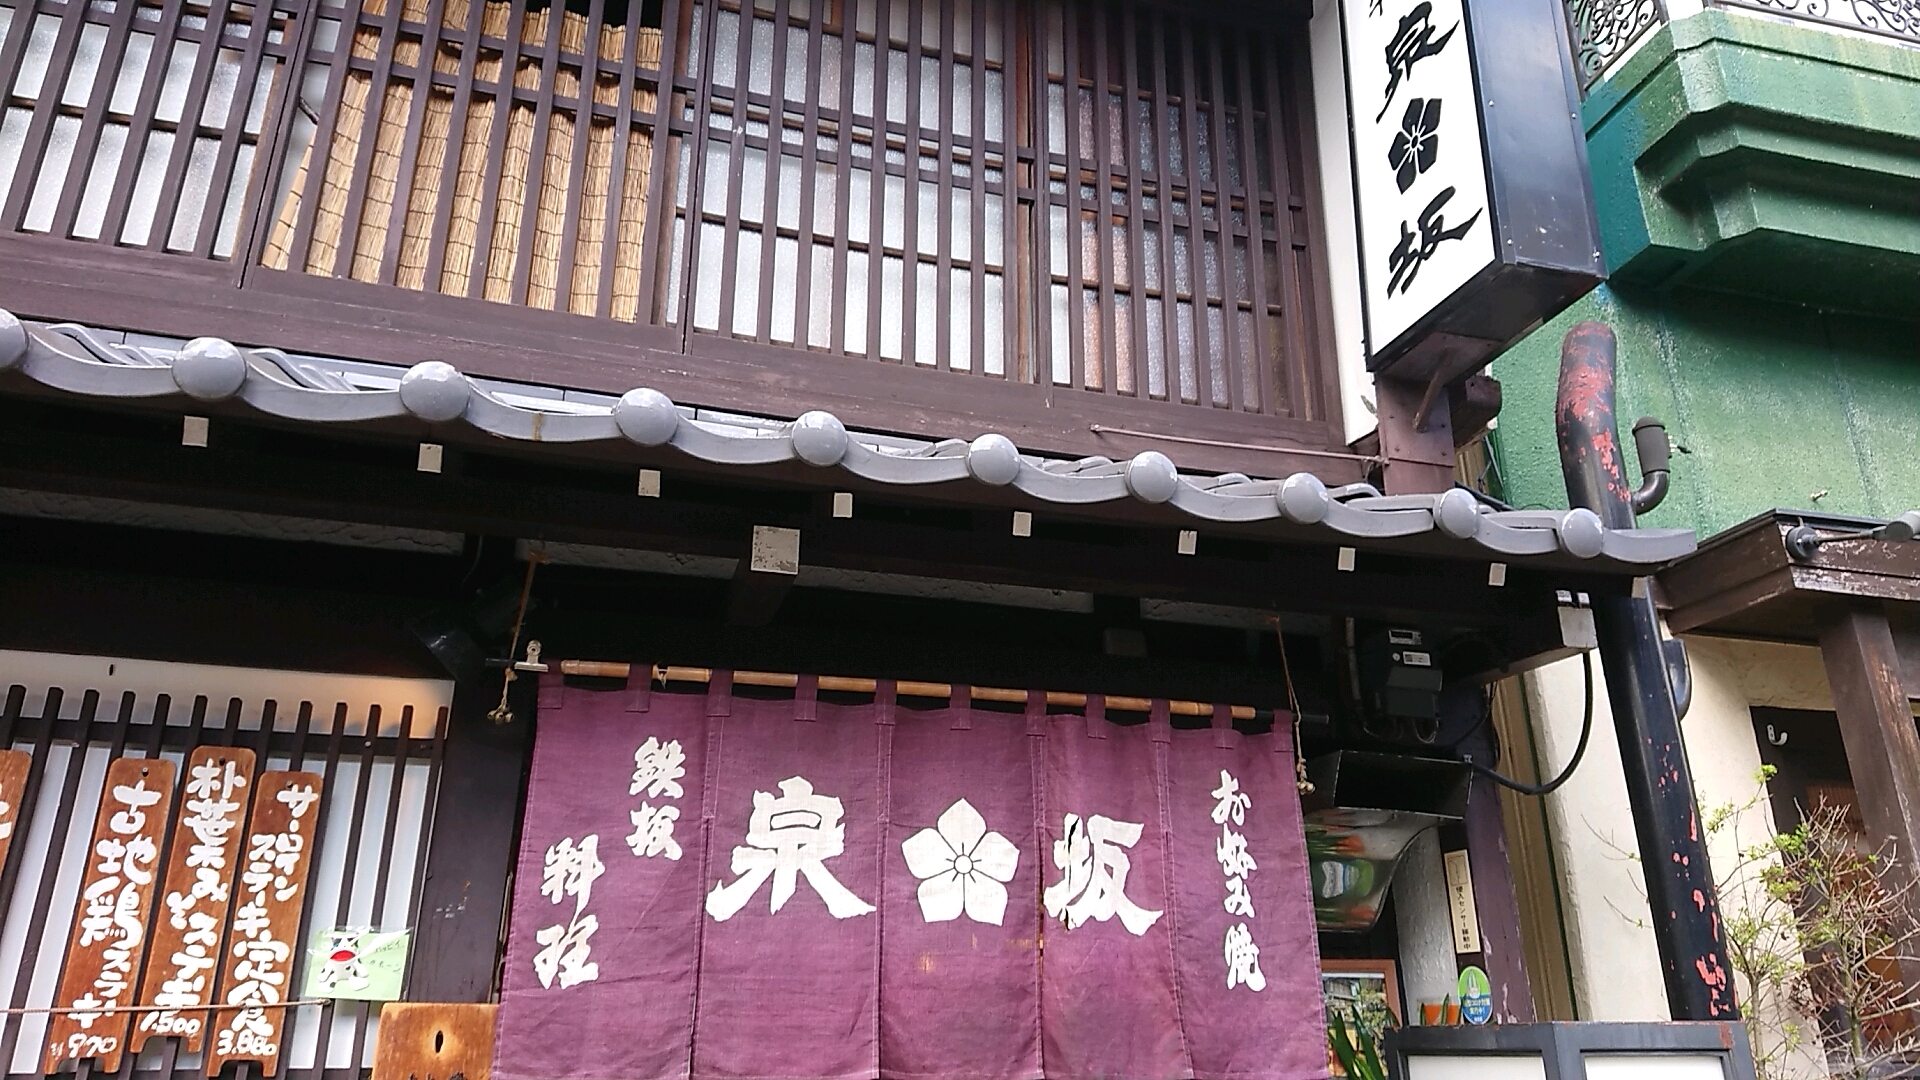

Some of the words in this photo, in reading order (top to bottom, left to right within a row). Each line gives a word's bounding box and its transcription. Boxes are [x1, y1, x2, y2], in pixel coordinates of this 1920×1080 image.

[1387, 186, 1484, 300] 坂
[533, 834, 606, 990] 料理
[705, 775, 877, 922] 泉
[1043, 812, 1164, 937] 坂
